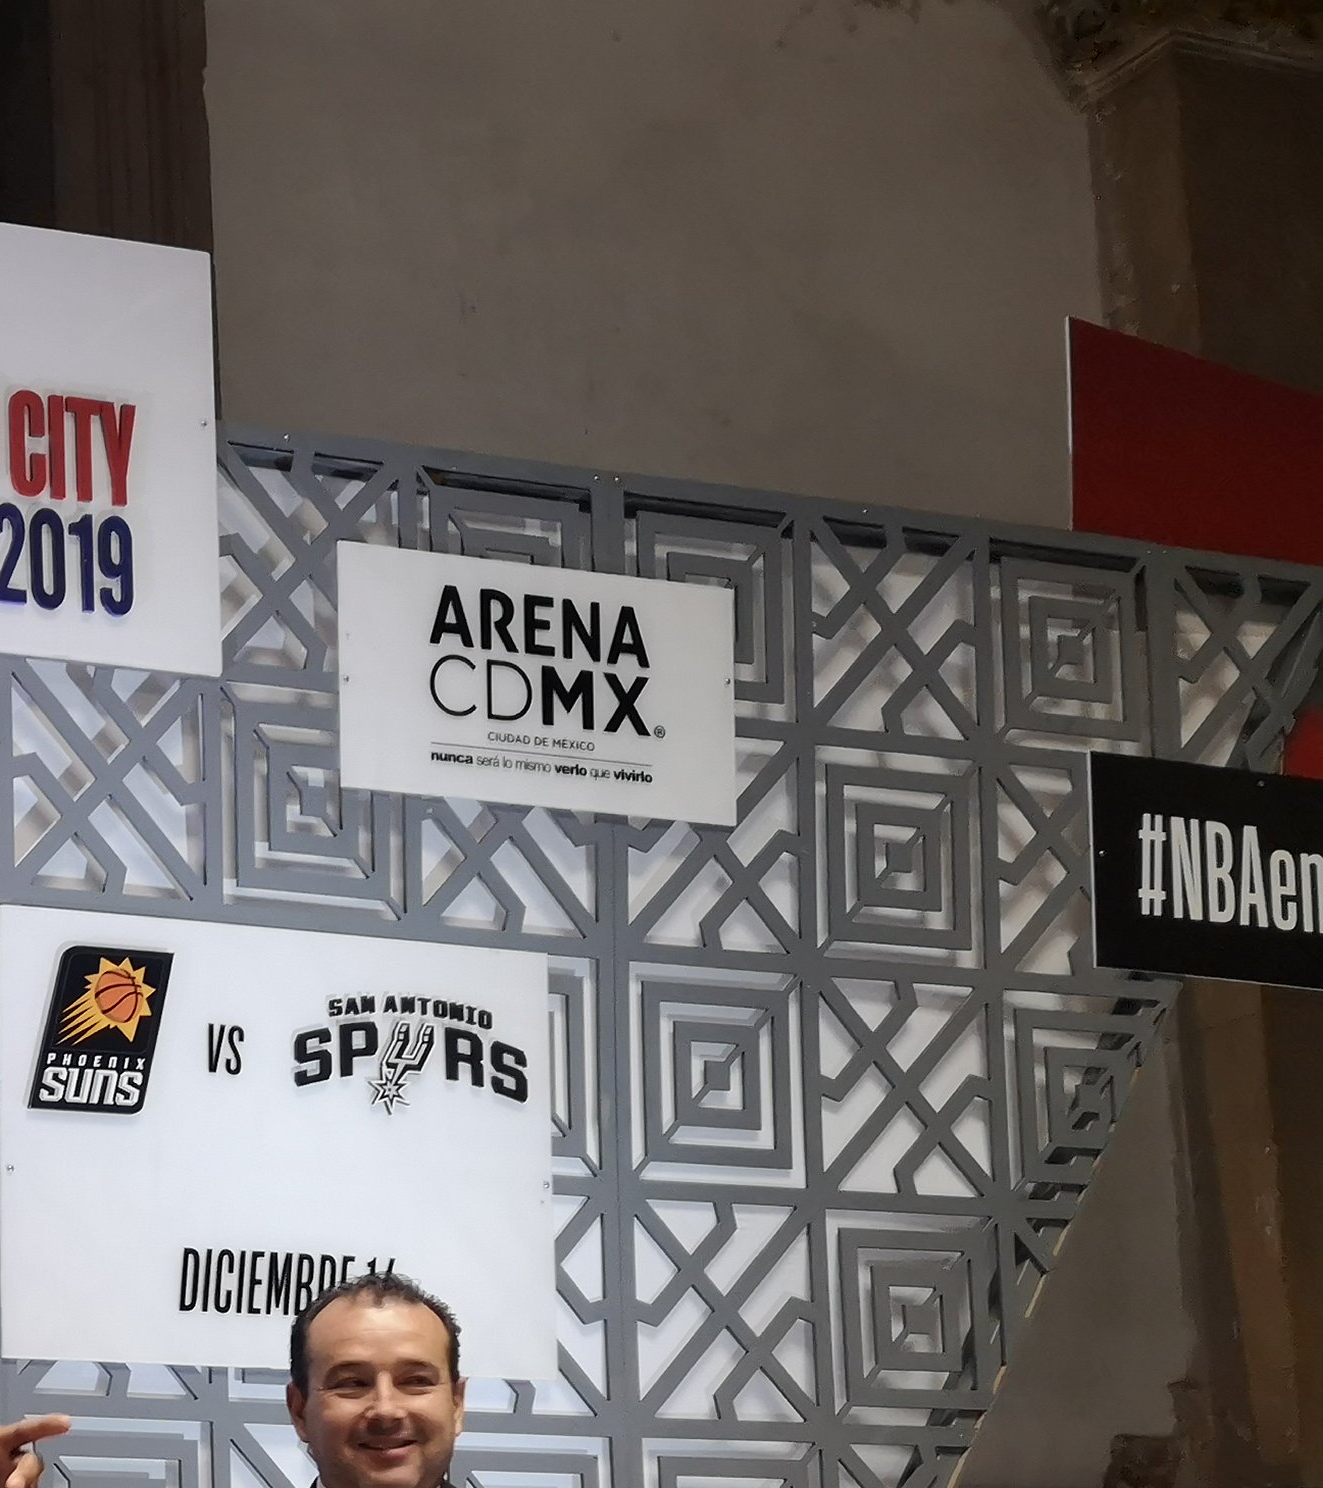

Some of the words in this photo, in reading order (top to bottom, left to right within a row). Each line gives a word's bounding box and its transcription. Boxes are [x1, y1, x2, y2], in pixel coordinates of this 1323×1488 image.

[8, 390, 136, 507] CITY
[429, 584, 650, 669] ARENA
[487, 731, 531, 746] CIUDAD
[534, 737, 549, 748] DE
[430, 751, 474, 765] nunca
[476, 755, 500, 768] será
[502, 756, 513, 769] lo
[515, 758, 551, 773] mismo
[554, 763, 588, 777] verlo
[590, 767, 611, 781] que
[613, 769, 653, 784] vivirlo
[1138, 813, 1323, 934] #NBAen
[328, 995, 376, 1017] SAN
[383, 995, 493, 1030] ANTONIO
[46, 1053, 146, 1070] PHOENIX
[208, 1023, 245, 1075] VS
[294, 1021, 528, 1115] SPURS
[39, 1066, 144, 1106] SUNS
